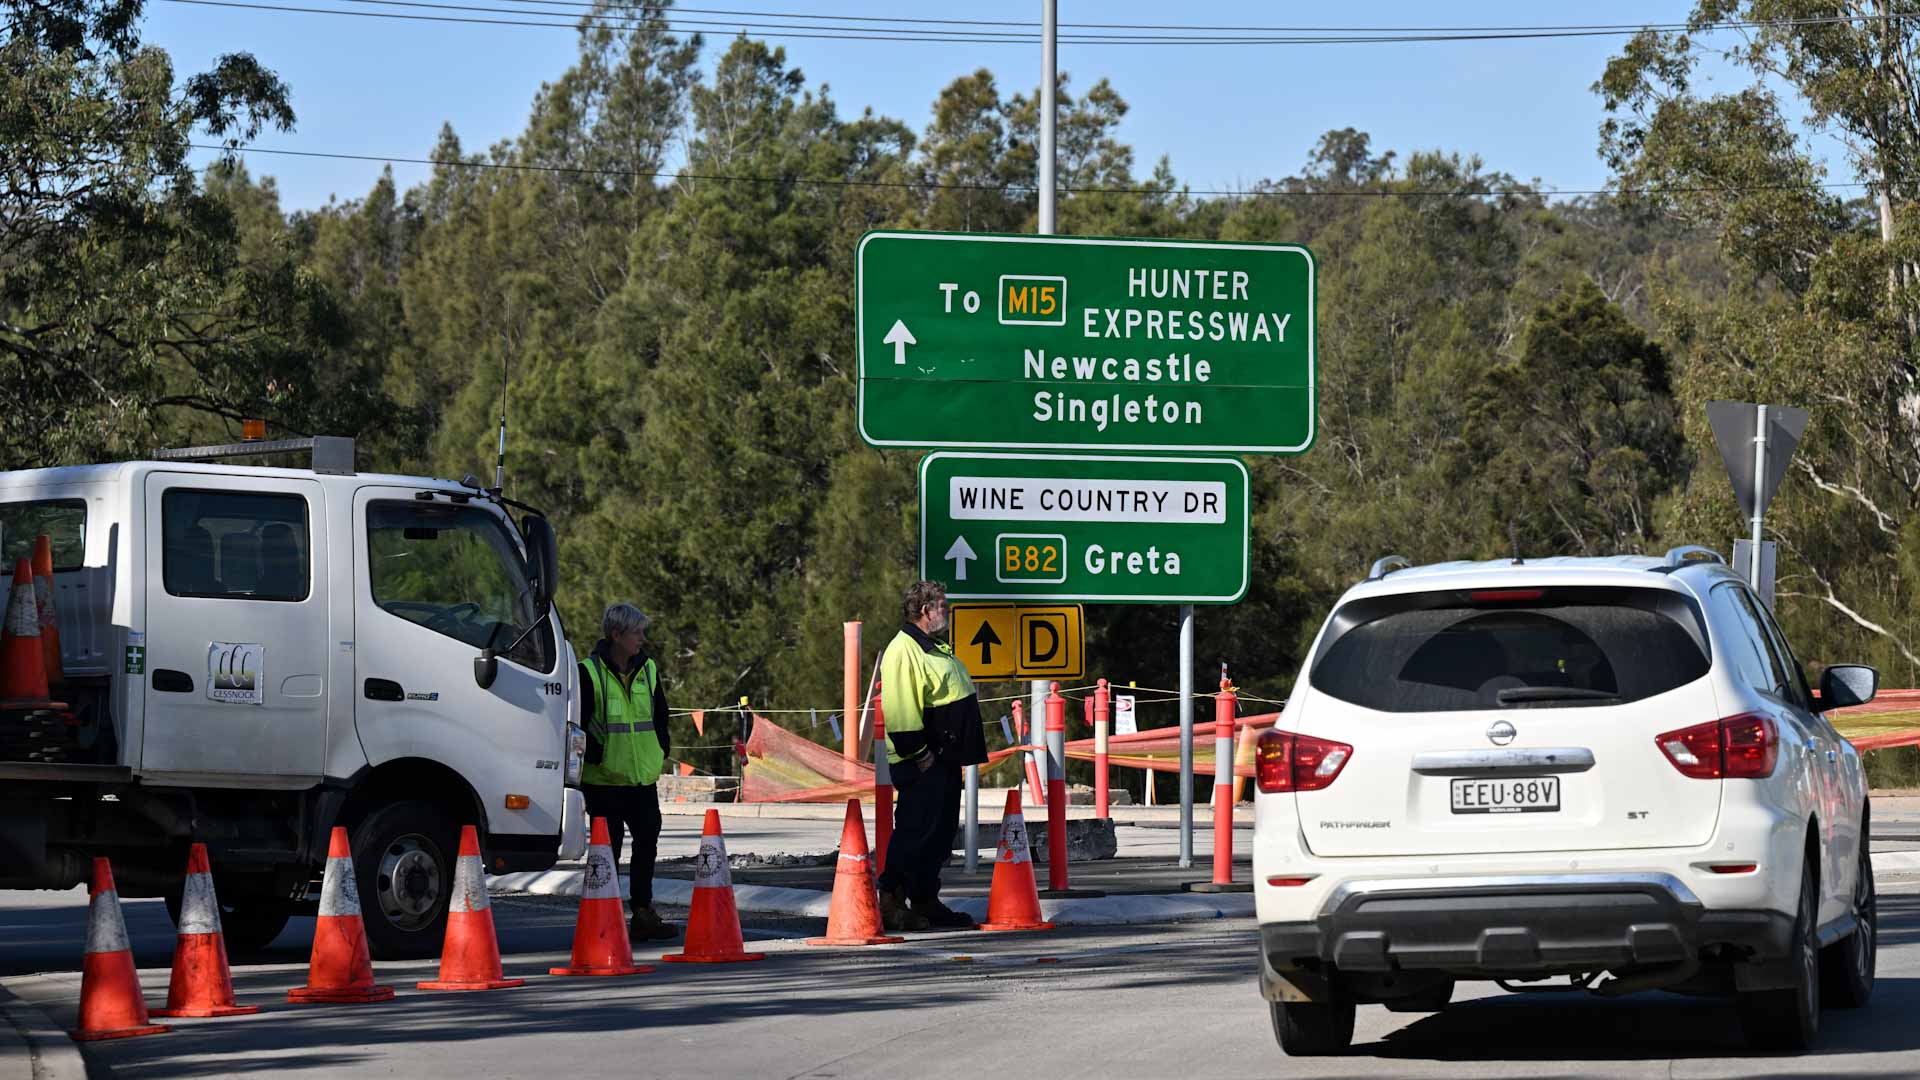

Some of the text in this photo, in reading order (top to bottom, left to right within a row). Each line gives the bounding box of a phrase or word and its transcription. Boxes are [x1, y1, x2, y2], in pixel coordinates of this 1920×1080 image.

[939, 283, 1056, 315] To M15
[1128, 268, 1249, 300] HUNTER
[1084, 308, 1291, 342] EXPRESSWAY
[1024, 350, 1211, 382] Newcastle
[1033, 392, 1202, 432] Singleton
[959, 488, 1218, 514] WINE COUNTRY DR
[1005, 544, 1180, 575] B82 Greta
[1029, 621, 1059, 662] D
[213, 690, 256, 699] CESSNOCK
[543, 682, 562, 695] 119
[1627, 811, 1649, 819] ST
